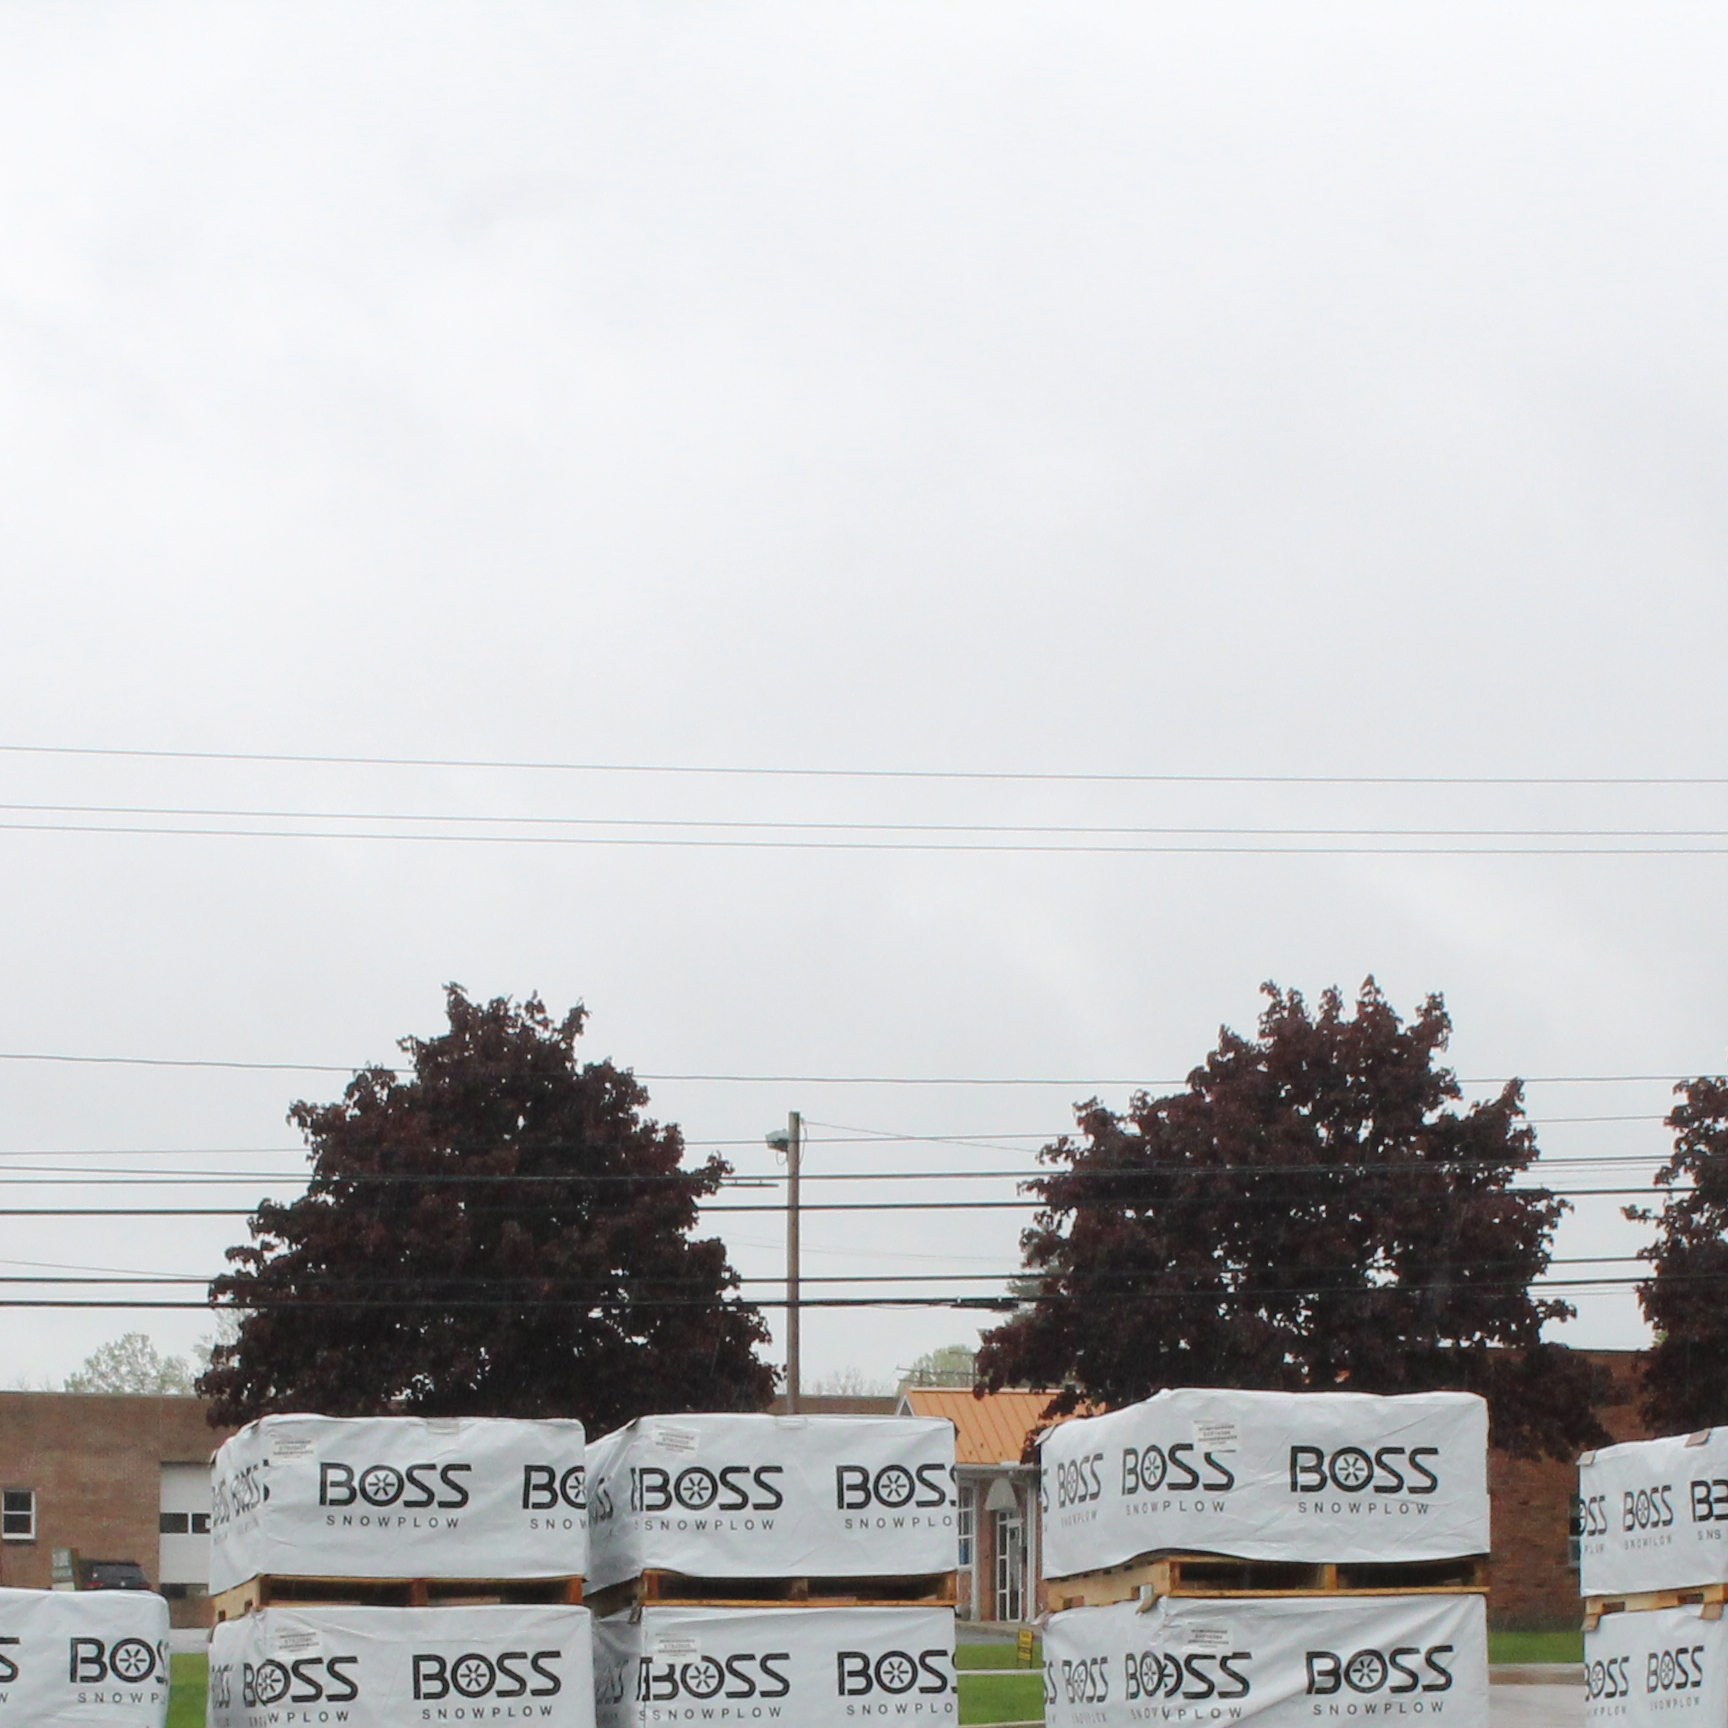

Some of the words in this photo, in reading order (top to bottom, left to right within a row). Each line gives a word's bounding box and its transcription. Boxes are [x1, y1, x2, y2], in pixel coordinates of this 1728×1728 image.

[320, 1463, 472, 1508] BOSS
[523, 1465, 585, 1509] BO
[632, 1467, 783, 1511] BOSS
[836, 1464, 956, 1509] BOS
[1058, 1453, 1103, 1508] BOSS
[1122, 1444, 1236, 1495] BOSS
[1290, 1445, 1438, 1494] BOSS
[327, 1515, 460, 1528] SNOWPLOW
[645, 1519, 774, 1531] SNOWPLOW
[845, 1516, 952, 1528] SNOWPLO
[1126, 1501, 1224, 1516] SNOWPLOW
[1299, 1502, 1429, 1514] SNOWPLOW
[1580, 1496, 1607, 1536] OSS
[1623, 1485, 1673, 1531] BOSS
[413, 1651, 562, 1700] BOSS
[838, 1650, 957, 1697] BOS
[1062, 1657, 1108, 1704] BOSS
[1306, 1646, 1453, 1695] BOSS
[1647, 1646, 1704, 1693] BOSS
[422, 1705, 552, 1719] SNOWPLOW
[847, 1703, 953, 1716] SNOWPLO
[1313, 1702, 1443, 1715] SNOWPLOW
